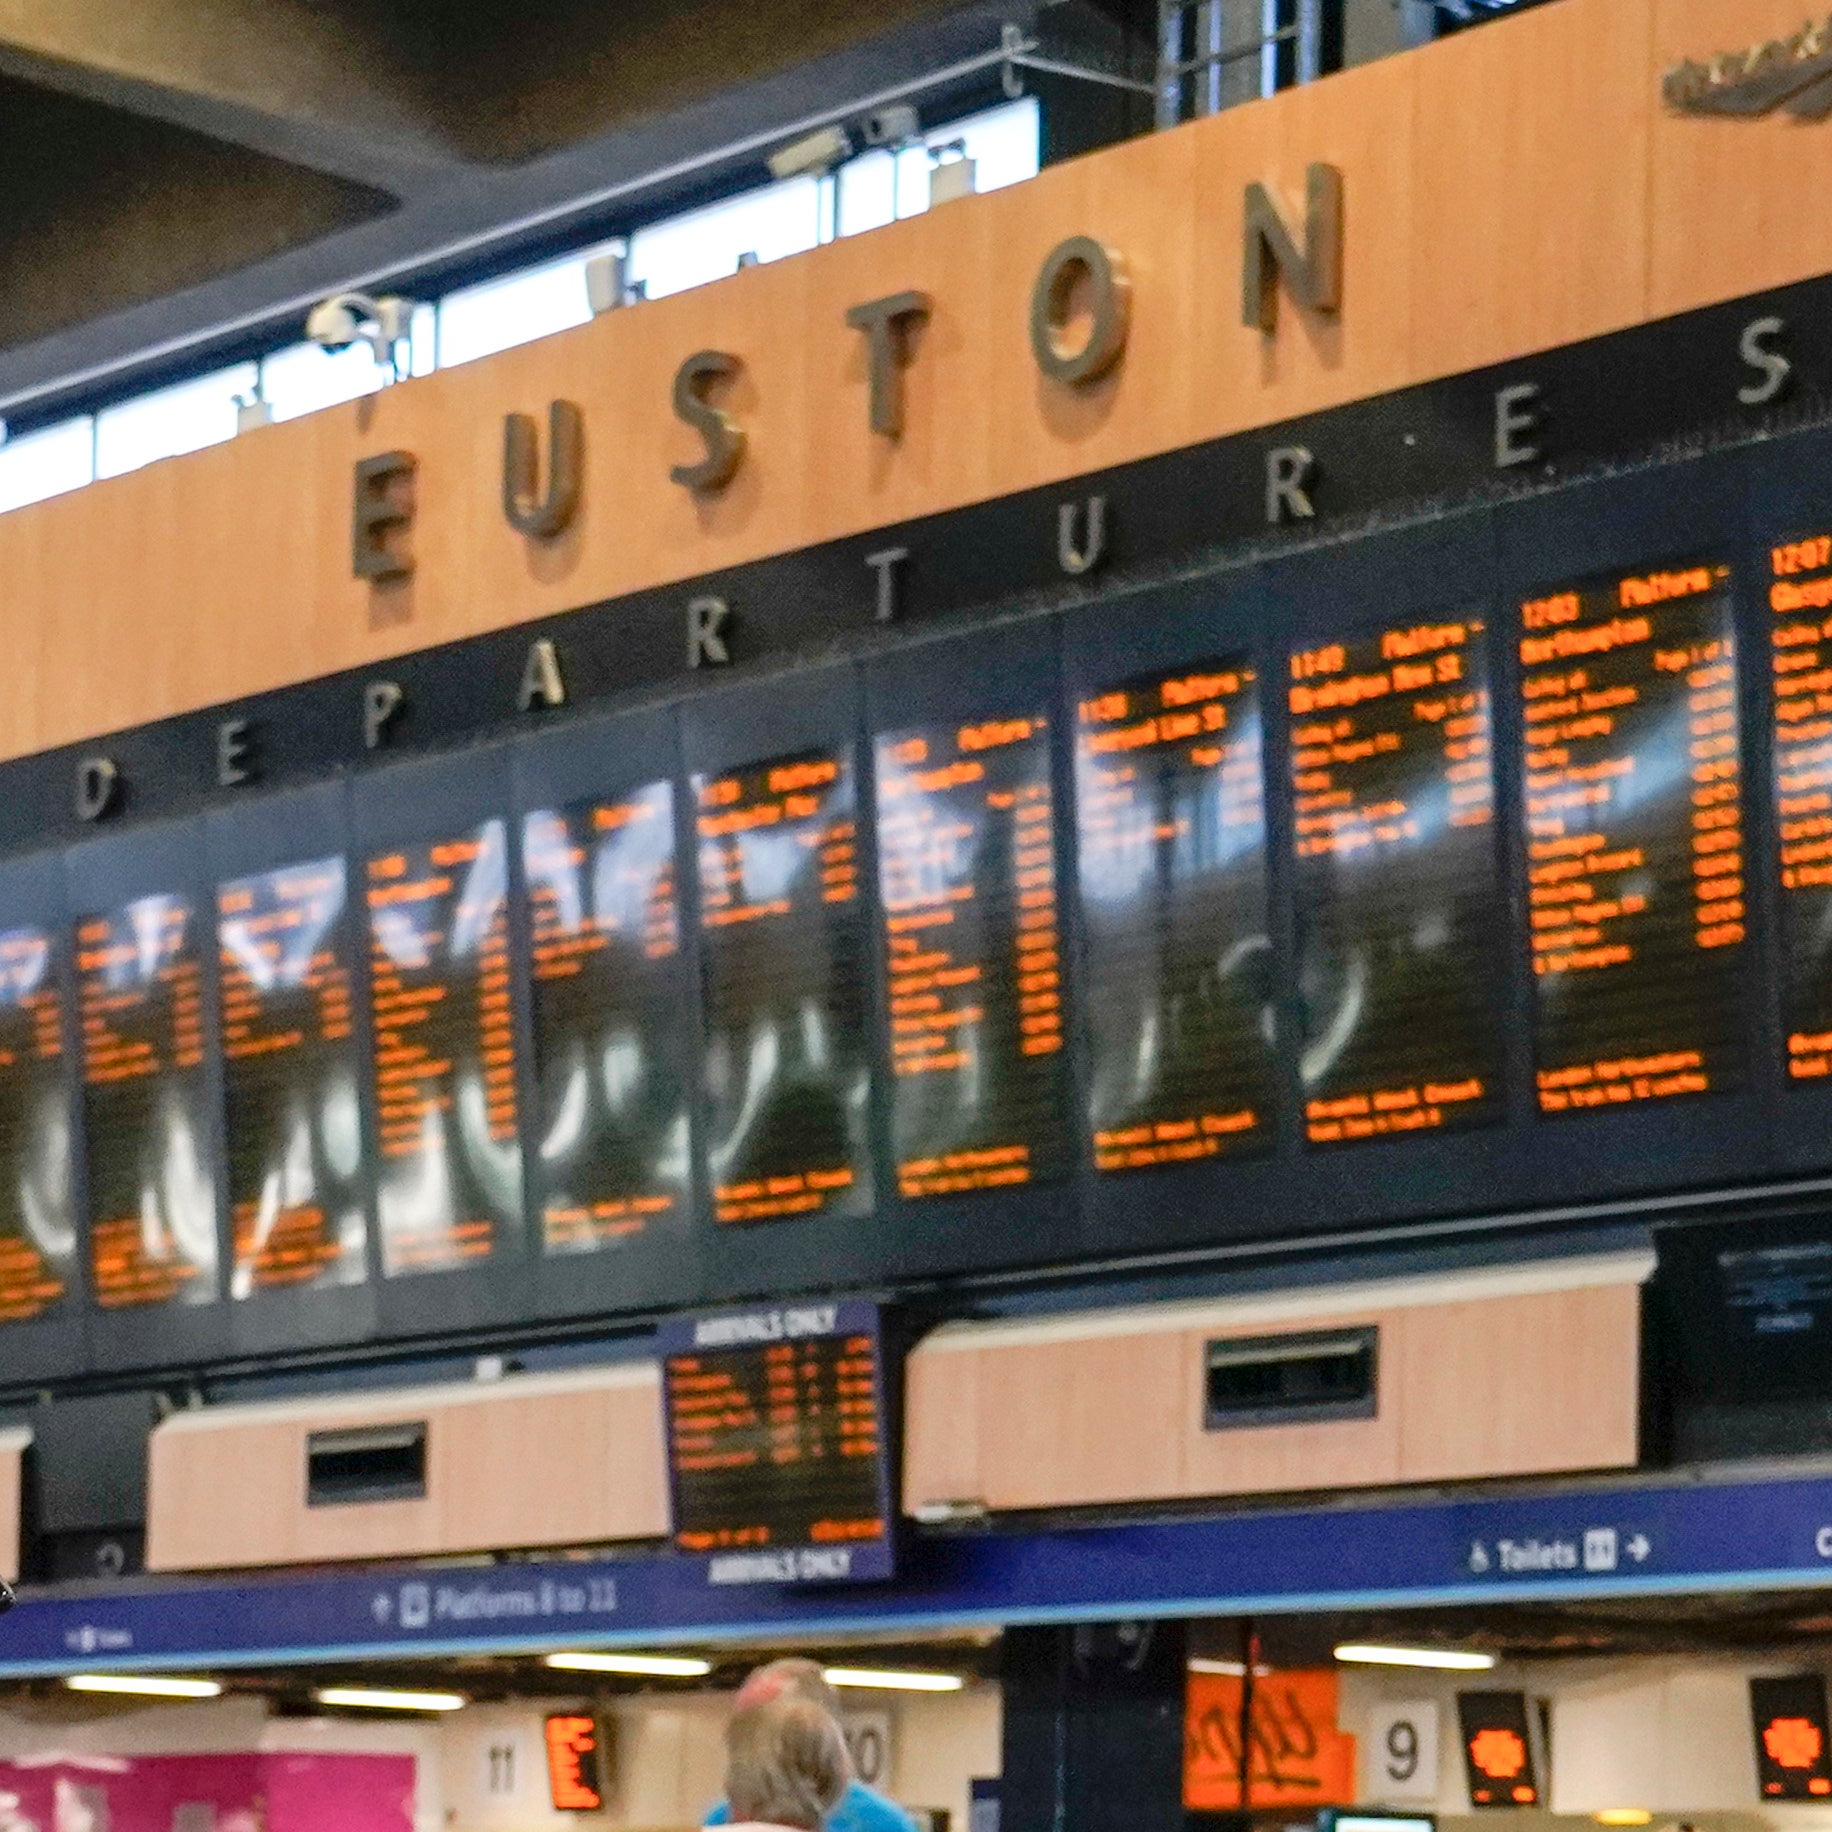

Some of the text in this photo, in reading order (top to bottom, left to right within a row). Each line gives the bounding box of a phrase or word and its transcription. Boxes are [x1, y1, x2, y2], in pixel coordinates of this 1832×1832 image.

[351, 160, 1346, 585] EUSTON
[72, 314, 1800, 822] DEPARTURES
[1499, 1534, 1579, 1572] Toilets
[1386, 1721, 1420, 1782] 9
